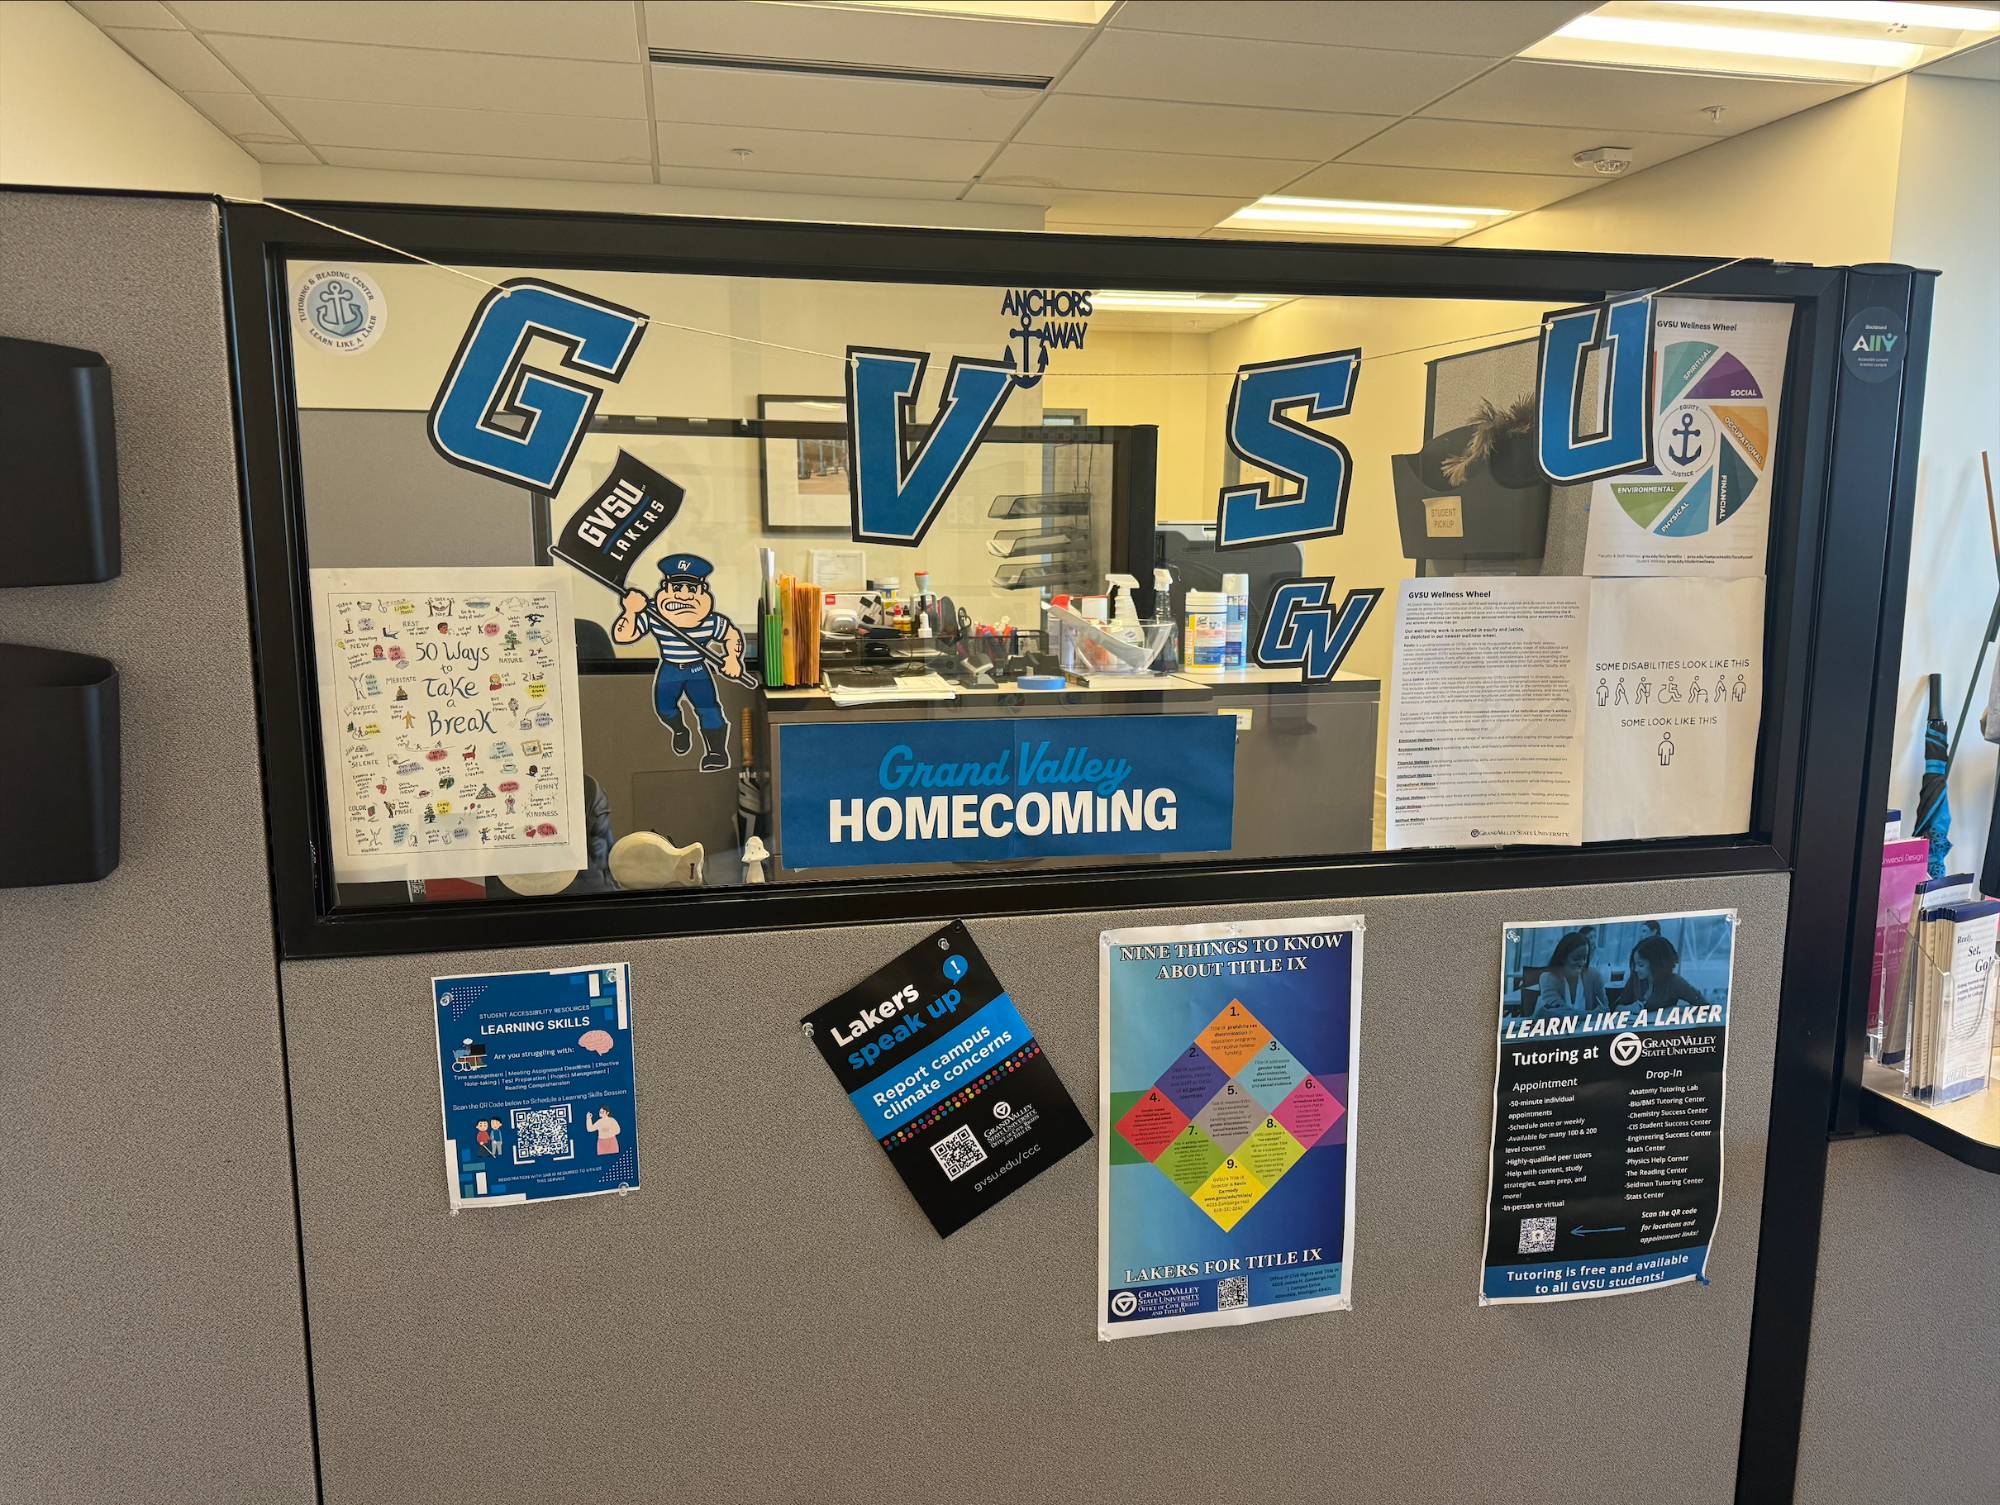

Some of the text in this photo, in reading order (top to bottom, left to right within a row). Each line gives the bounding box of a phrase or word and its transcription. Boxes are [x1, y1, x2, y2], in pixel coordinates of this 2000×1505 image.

[298, 285, 309, 322] TUTORING
[316, 271, 349, 281] READING
[352, 277, 374, 300] CENTER
[1001, 289, 1092, 317] ANCHORS
[309, 328, 333, 346] LEARN
[362, 316, 376, 337] LAKER
[1040, 322, 1088, 349] AWAY
[1680, 321, 1710, 330] Wellness
[1713, 322, 1737, 331] Wheel
[1684, 348, 1712, 381] SPIRITUAL
[1730, 389, 1757, 397] SOCIAL
[426, 277, 1657, 551] G V S U
[1724, 416, 1763, 464] OCCUPATIONAL
[1618, 486, 1675, 494] ENVIRONMENTAL
[577, 479, 644, 547] GVSU
[1661, 501, 1690, 532] PHYSICAL
[610, 500, 665, 561] LAKERS
[678, 560, 691, 571] GV
[1253, 576, 1384, 683] GV
[415, 641, 490, 670] 50 Ways
[1596, 659, 1750, 671] SOME DISABILITIES LOOK LIKE THIS
[440, 664, 452, 674] to
[447, 699, 456, 708] a
[1621, 716, 1717, 727] SOME LOOK LIKE THIS
[878, 740, 1132, 795] Grand Valley
[829, 787, 1178, 844] HOMECOMING
[1905, 853, 1924, 862] Design
[1120, 934, 1343, 962] NINE THINGS TO KNOW
[1156, 956, 1307, 980] ABOUT TITLE IX
[509, 1009, 552, 1018] ACCESSIBILITY
[554, 1005, 590, 1013] RESOURCES
[830, 983, 919, 1047] Lakers
[1505, 1004, 1723, 1039] LEARN LIKE A LAKER
[481, 1017, 590, 1035] LEARNING SKILLS
[847, 988, 961, 1070] speak up
[508, 1052, 520, 1061] you
[522, 1048, 555, 1059] struggling
[557, 1047, 575, 1055] with:
[1641, 1046, 1717, 1057] STATE UNIVERSITY
[1642, 1036, 1717, 1049] GRAND VALLEY
[872, 1025, 991, 1106] Report campus
[1512, 1045, 1599, 1066] Tutoring at
[883, 1030, 1012, 1121] climate concerns
[1512, 1078, 1578, 1093] Appointment
[1646, 1069, 1682, 1080] Drop-In
[1544, 1095, 1574, 1104] individual
[984, 1104, 1032, 1137] GRAND VALLEY
[987, 1109, 1037, 1142] STATE UNIVERSITY
[1508, 1110, 1552, 1120] appointments
[974, 1144, 1040, 1192] gvsu.edu/ccc
[1640, 1168, 1665, 1176] Reading
[1640, 1230, 1699, 1244] appointment links!
[1652, 1222, 1681, 1230] locations
[1125, 1248, 1322, 1283] LAKERS FOR TITLE IX
[1507, 1254, 1688, 1281] Tutoring is free and available
[1535, 1271, 1664, 1294] to all GVSU students!
[1159, 1294, 1199, 1304] UNIVERSITY
